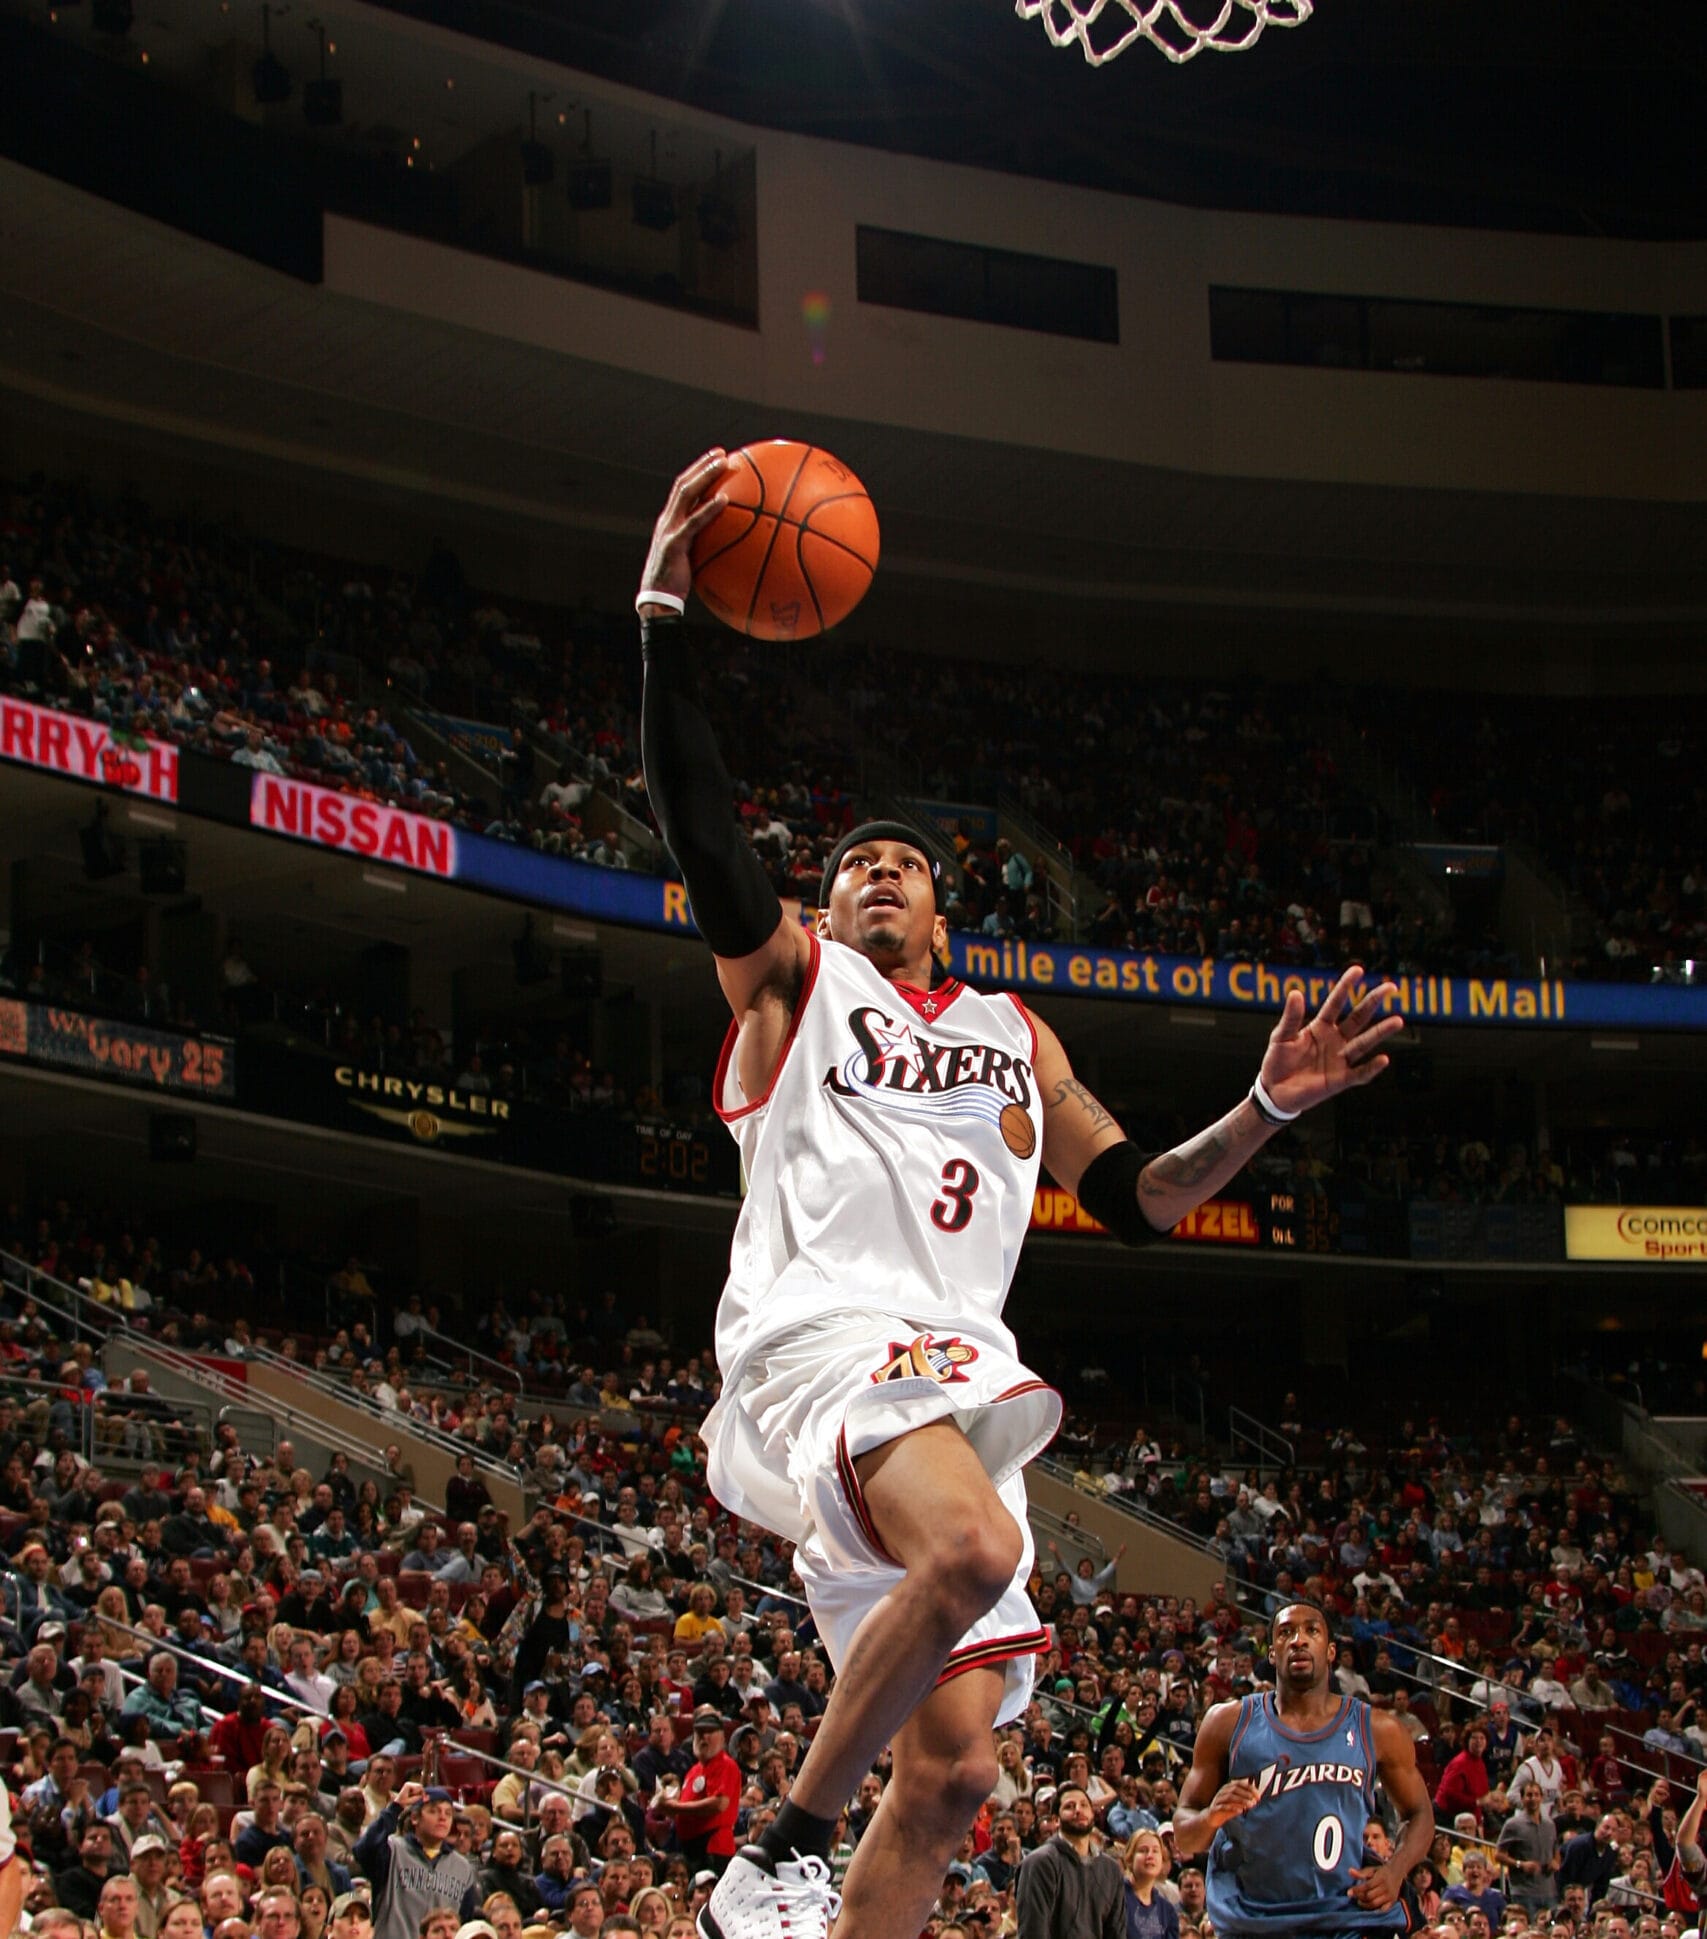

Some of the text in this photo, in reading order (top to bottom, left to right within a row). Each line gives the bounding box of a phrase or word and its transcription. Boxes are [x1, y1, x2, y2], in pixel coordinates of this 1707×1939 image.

[264, 780, 449, 876] NISSAN
[965, 938, 1054, 982] mile
[1069, 956, 1160, 991] east
[1172, 959, 1215, 996] of
[1383, 976, 1452, 1014] Hill
[1469, 980, 1565, 1018] Mall
[181, 1040, 224, 1087] 25
[334, 1066, 509, 1119] CHRYSLER
[822, 1007, 1032, 1109] SIXERS
[930, 1158, 980, 1233] 3
[1313, 1814, 1344, 1872] 0
